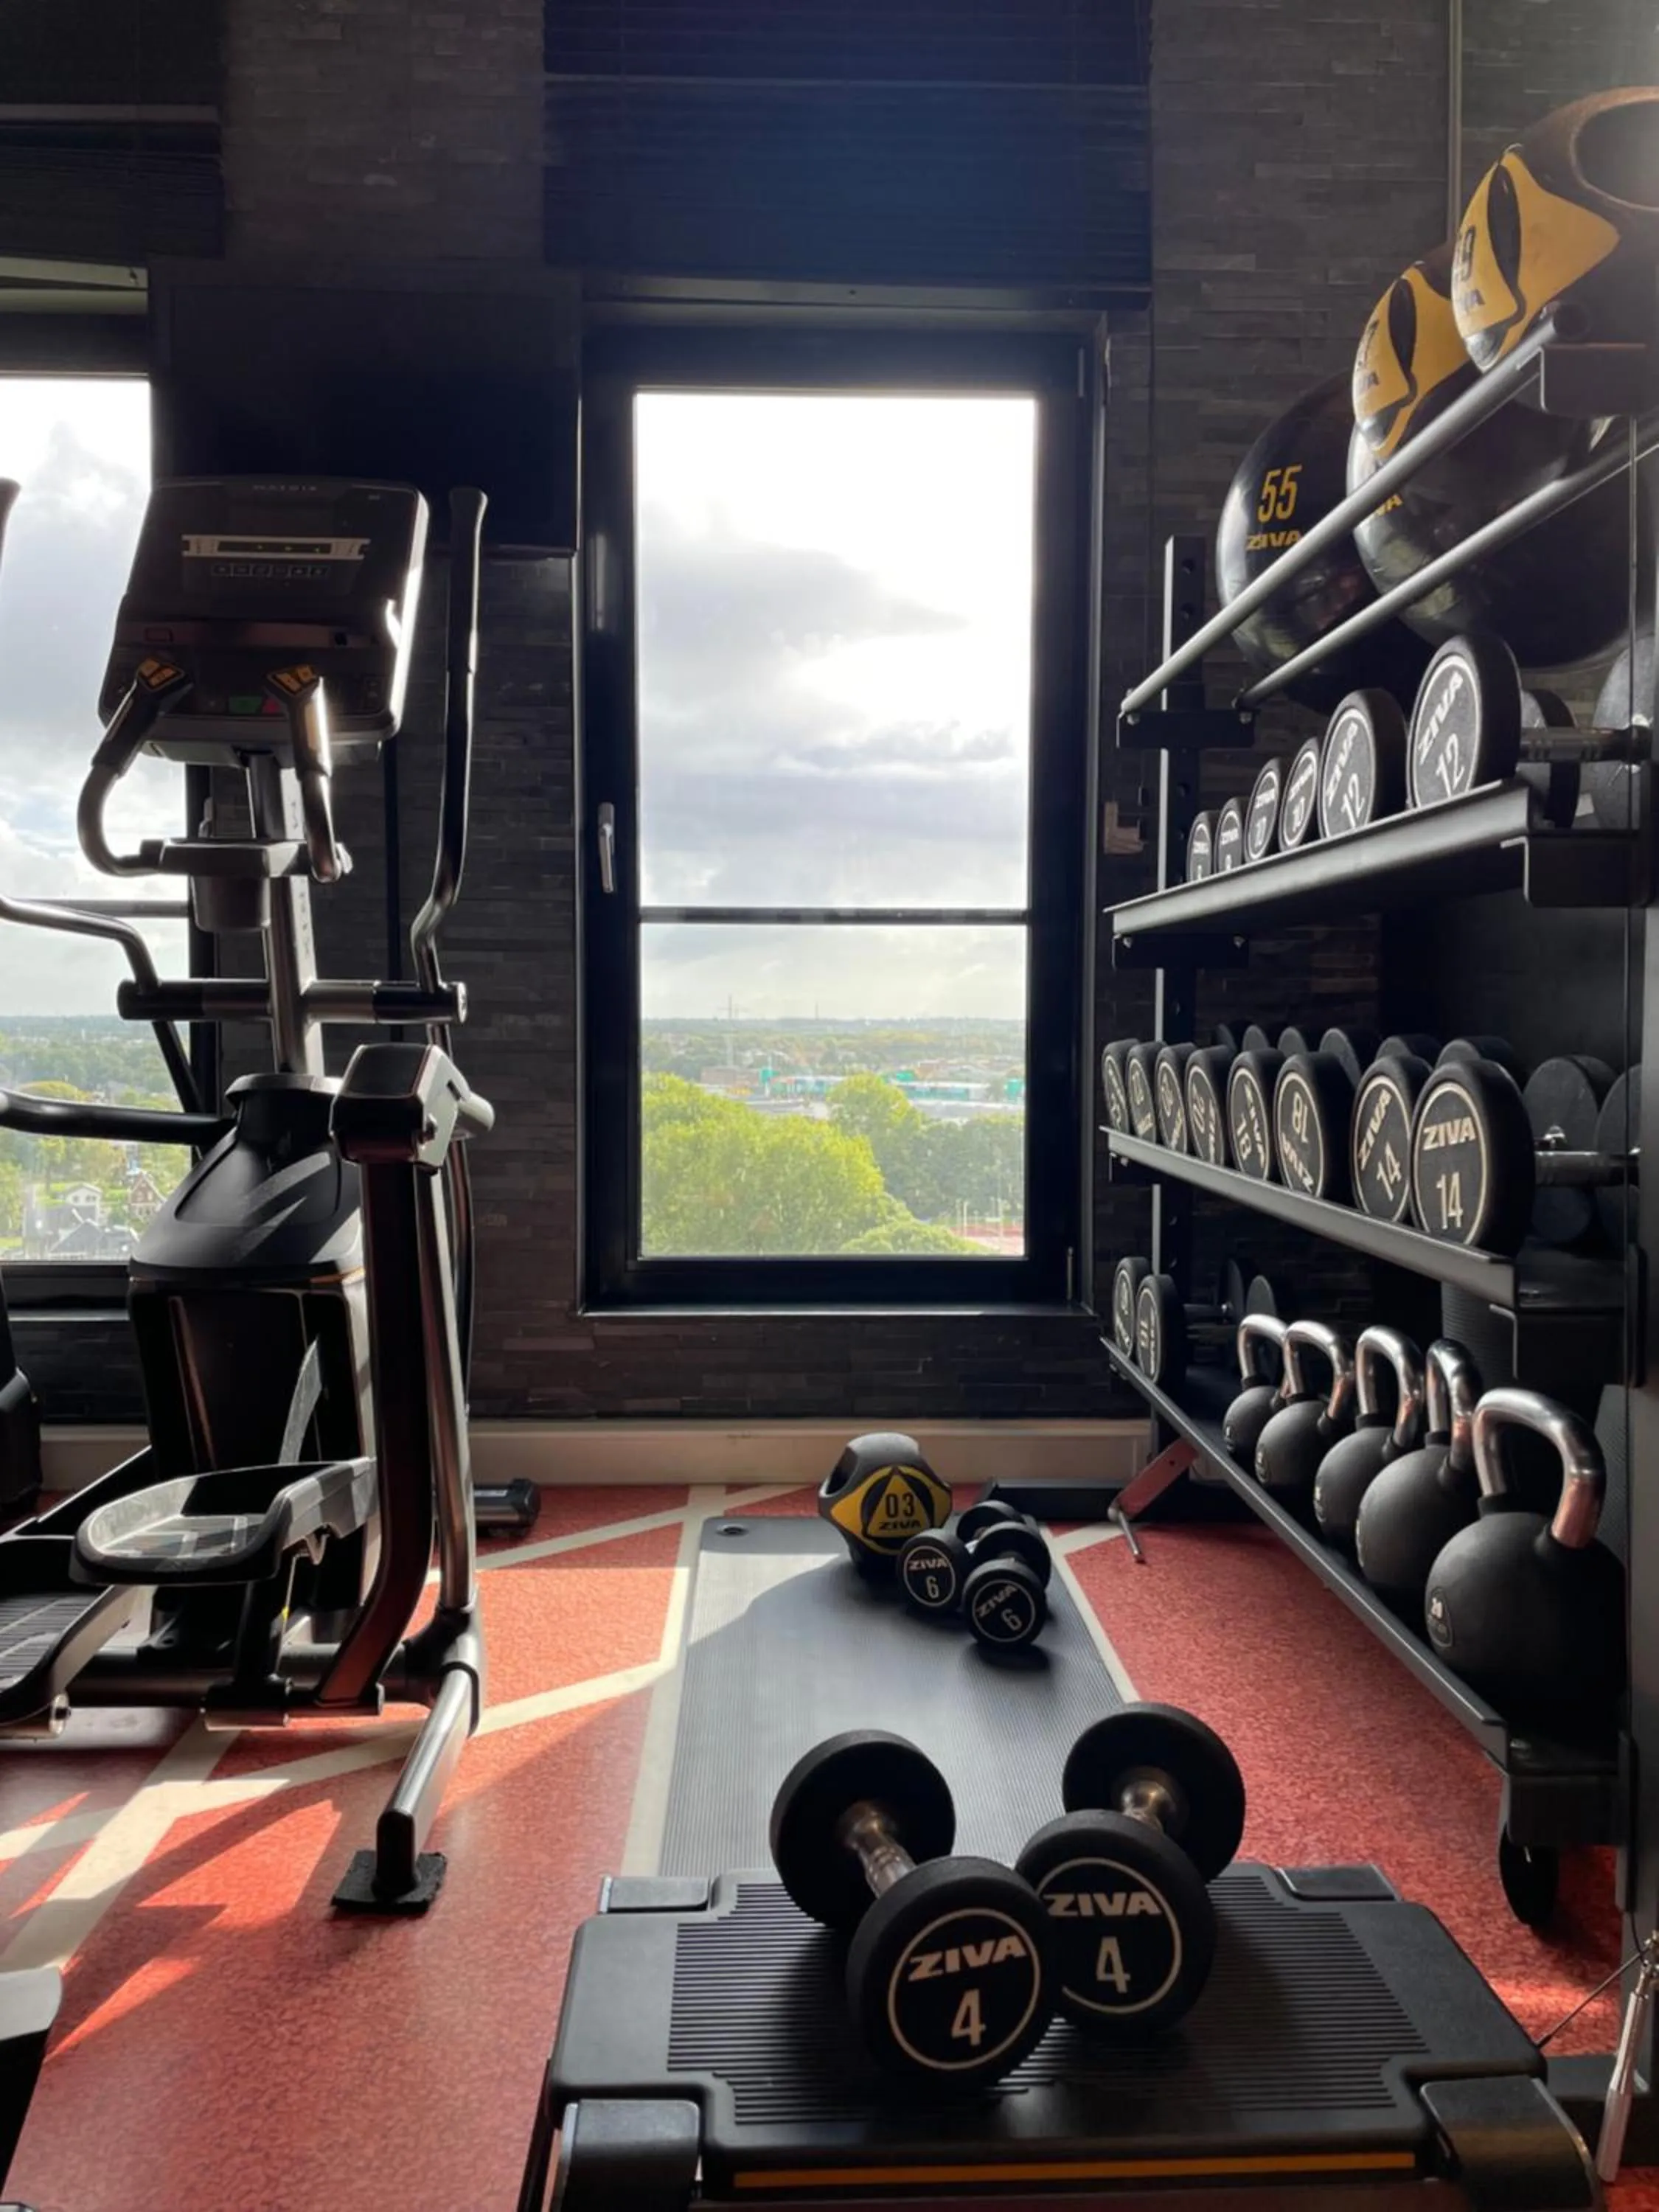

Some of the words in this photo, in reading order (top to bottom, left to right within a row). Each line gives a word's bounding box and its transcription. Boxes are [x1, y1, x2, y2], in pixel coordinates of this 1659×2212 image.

[1256, 464, 1303, 524] 55
[1246, 530, 1304, 551] ZIVA
[1417, 670, 1464, 766] ZIVA
[1325, 721, 1359, 807] ZIVA
[1435, 732, 1466, 799] 12
[1340, 772, 1366, 830] 12
[1357, 1088, 1393, 1171] ZIVA
[1422, 1116, 1476, 1152] ZIVA
[1376, 1141, 1402, 1202] 14
[1436, 1171, 1464, 1230] 14
[877, 1519, 922, 1531] ZIVA
[884, 1490, 914, 1518] 03
[908, 1557, 950, 1573] ZIVA
[925, 1575, 939, 1600] 6
[975, 1583, 1019, 1618] ZIVA
[1000, 1607, 1022, 1632] 6
[1042, 1891, 1163, 1917] ZIVA
[908, 1935, 1029, 1983] ZIVA
[1095, 1935, 1132, 1994] 4
[950, 1988, 987, 2047] 4
